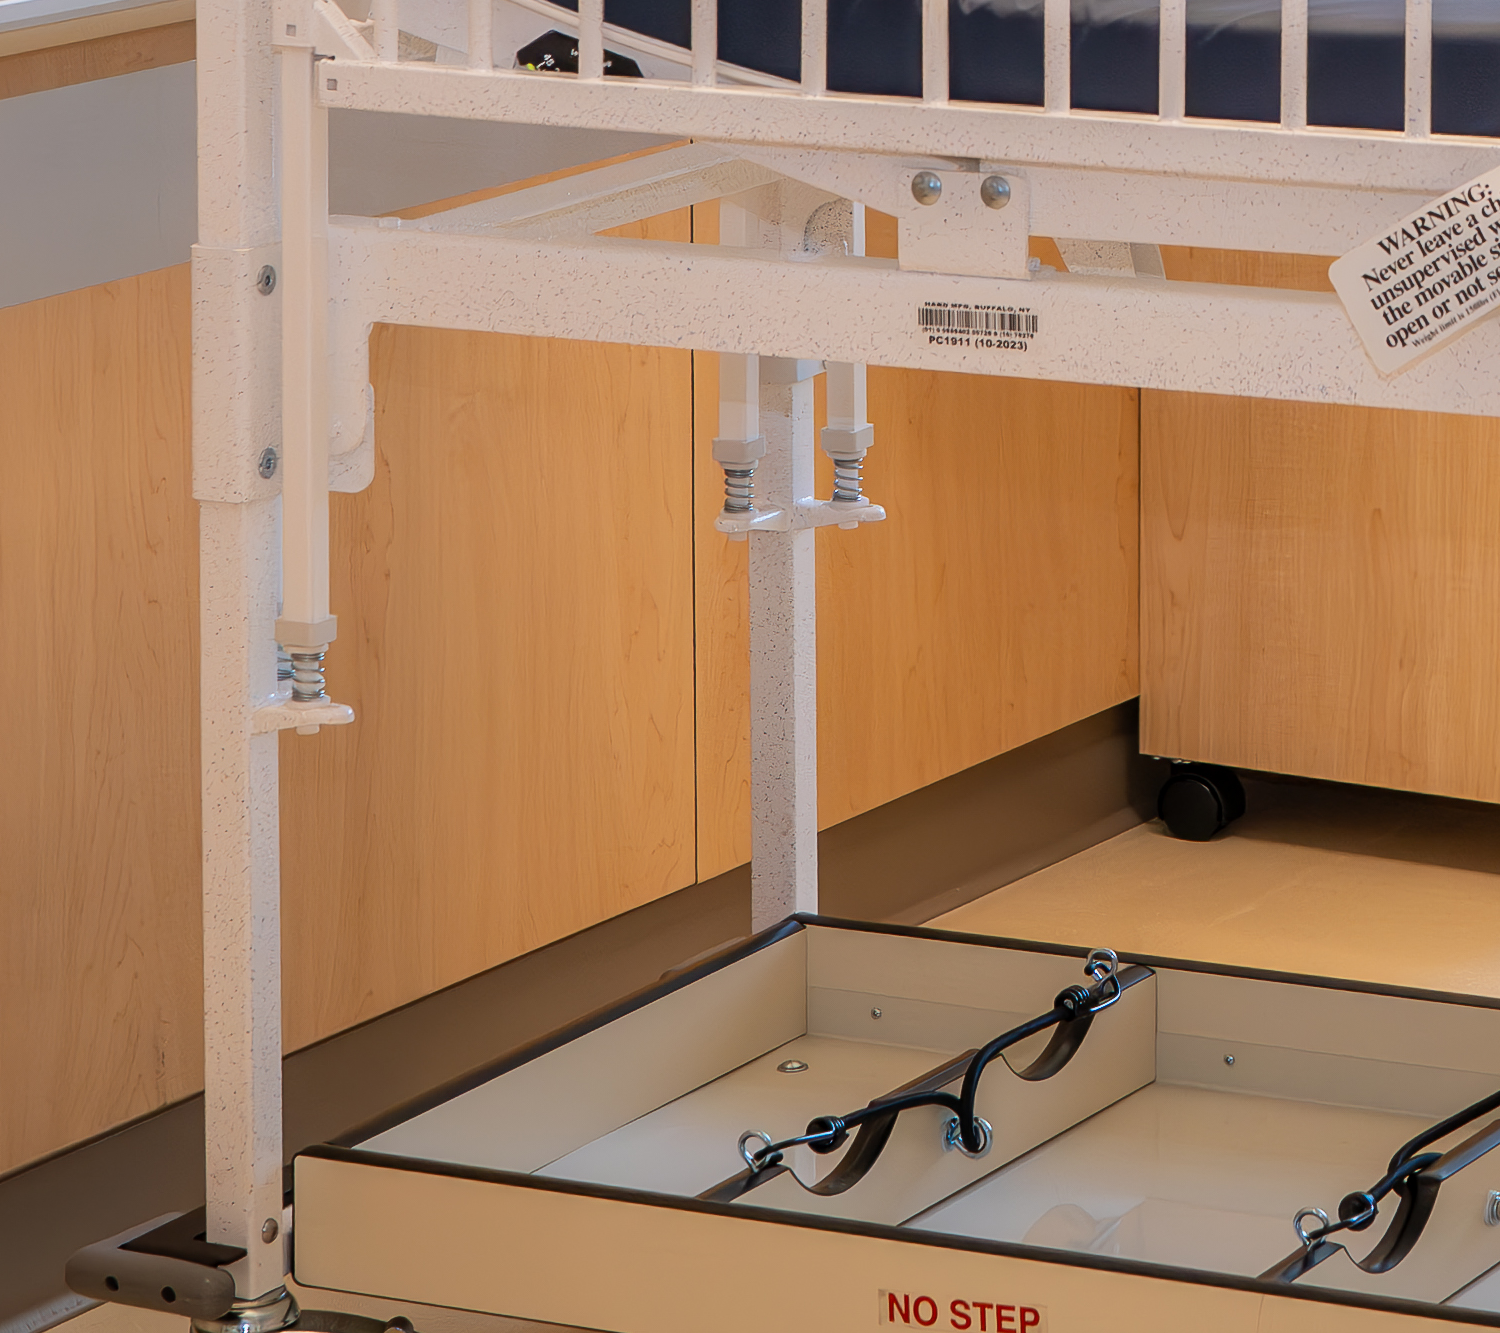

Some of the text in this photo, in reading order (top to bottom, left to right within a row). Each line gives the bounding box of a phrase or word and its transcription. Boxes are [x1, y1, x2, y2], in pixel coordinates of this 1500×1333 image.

[1361, 249, 1415, 292] Never
[1416, 222, 1464, 258] leave
[1466, 213, 1479, 228] a
[1377, 183, 1493, 256] WARNING:
[1370, 226, 1487, 311] unsupervised
[1382, 298, 1414, 326] the
[1415, 252, 1489, 307] movable
[928, 335, 1028, 352] PC1911 (10-2023)
[974, 304, 1017, 314] BUFFALO,
[1385, 313, 1430, 349] open
[1432, 298, 1454, 319] or
[1455, 276, 1487, 306] not
[1411, 330, 1440, 349] Weight
[1438, 314, 1459, 331] limit
[888, 1291, 1041, 1333] NO STEP
